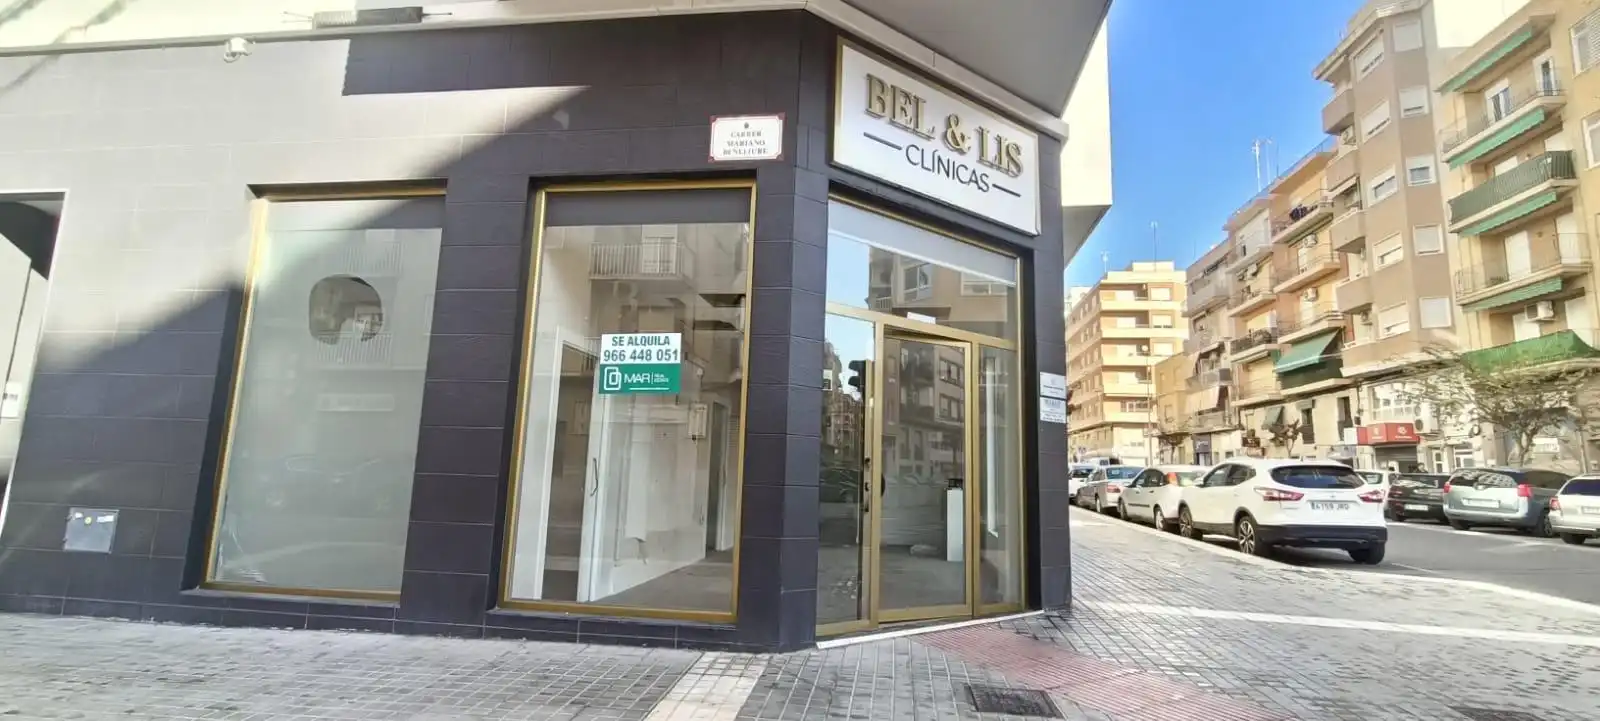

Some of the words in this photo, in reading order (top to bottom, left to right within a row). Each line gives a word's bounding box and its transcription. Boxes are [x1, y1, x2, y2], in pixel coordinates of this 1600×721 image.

[865, 73, 935, 141] BEL
[944, 113, 971, 155] &
[976, 126, 1022, 178] LIS
[730, 130, 762, 138] CARRER
[905, 143, 990, 193] CLÍNICAS
[611, 336, 625, 346] SE
[627, 335, 670, 346] ALQUILA
[603, 349, 626, 362] 966
[629, 349, 652, 361] 448
[656, 348, 678, 361] 051
[623, 372, 651, 384] MAR
